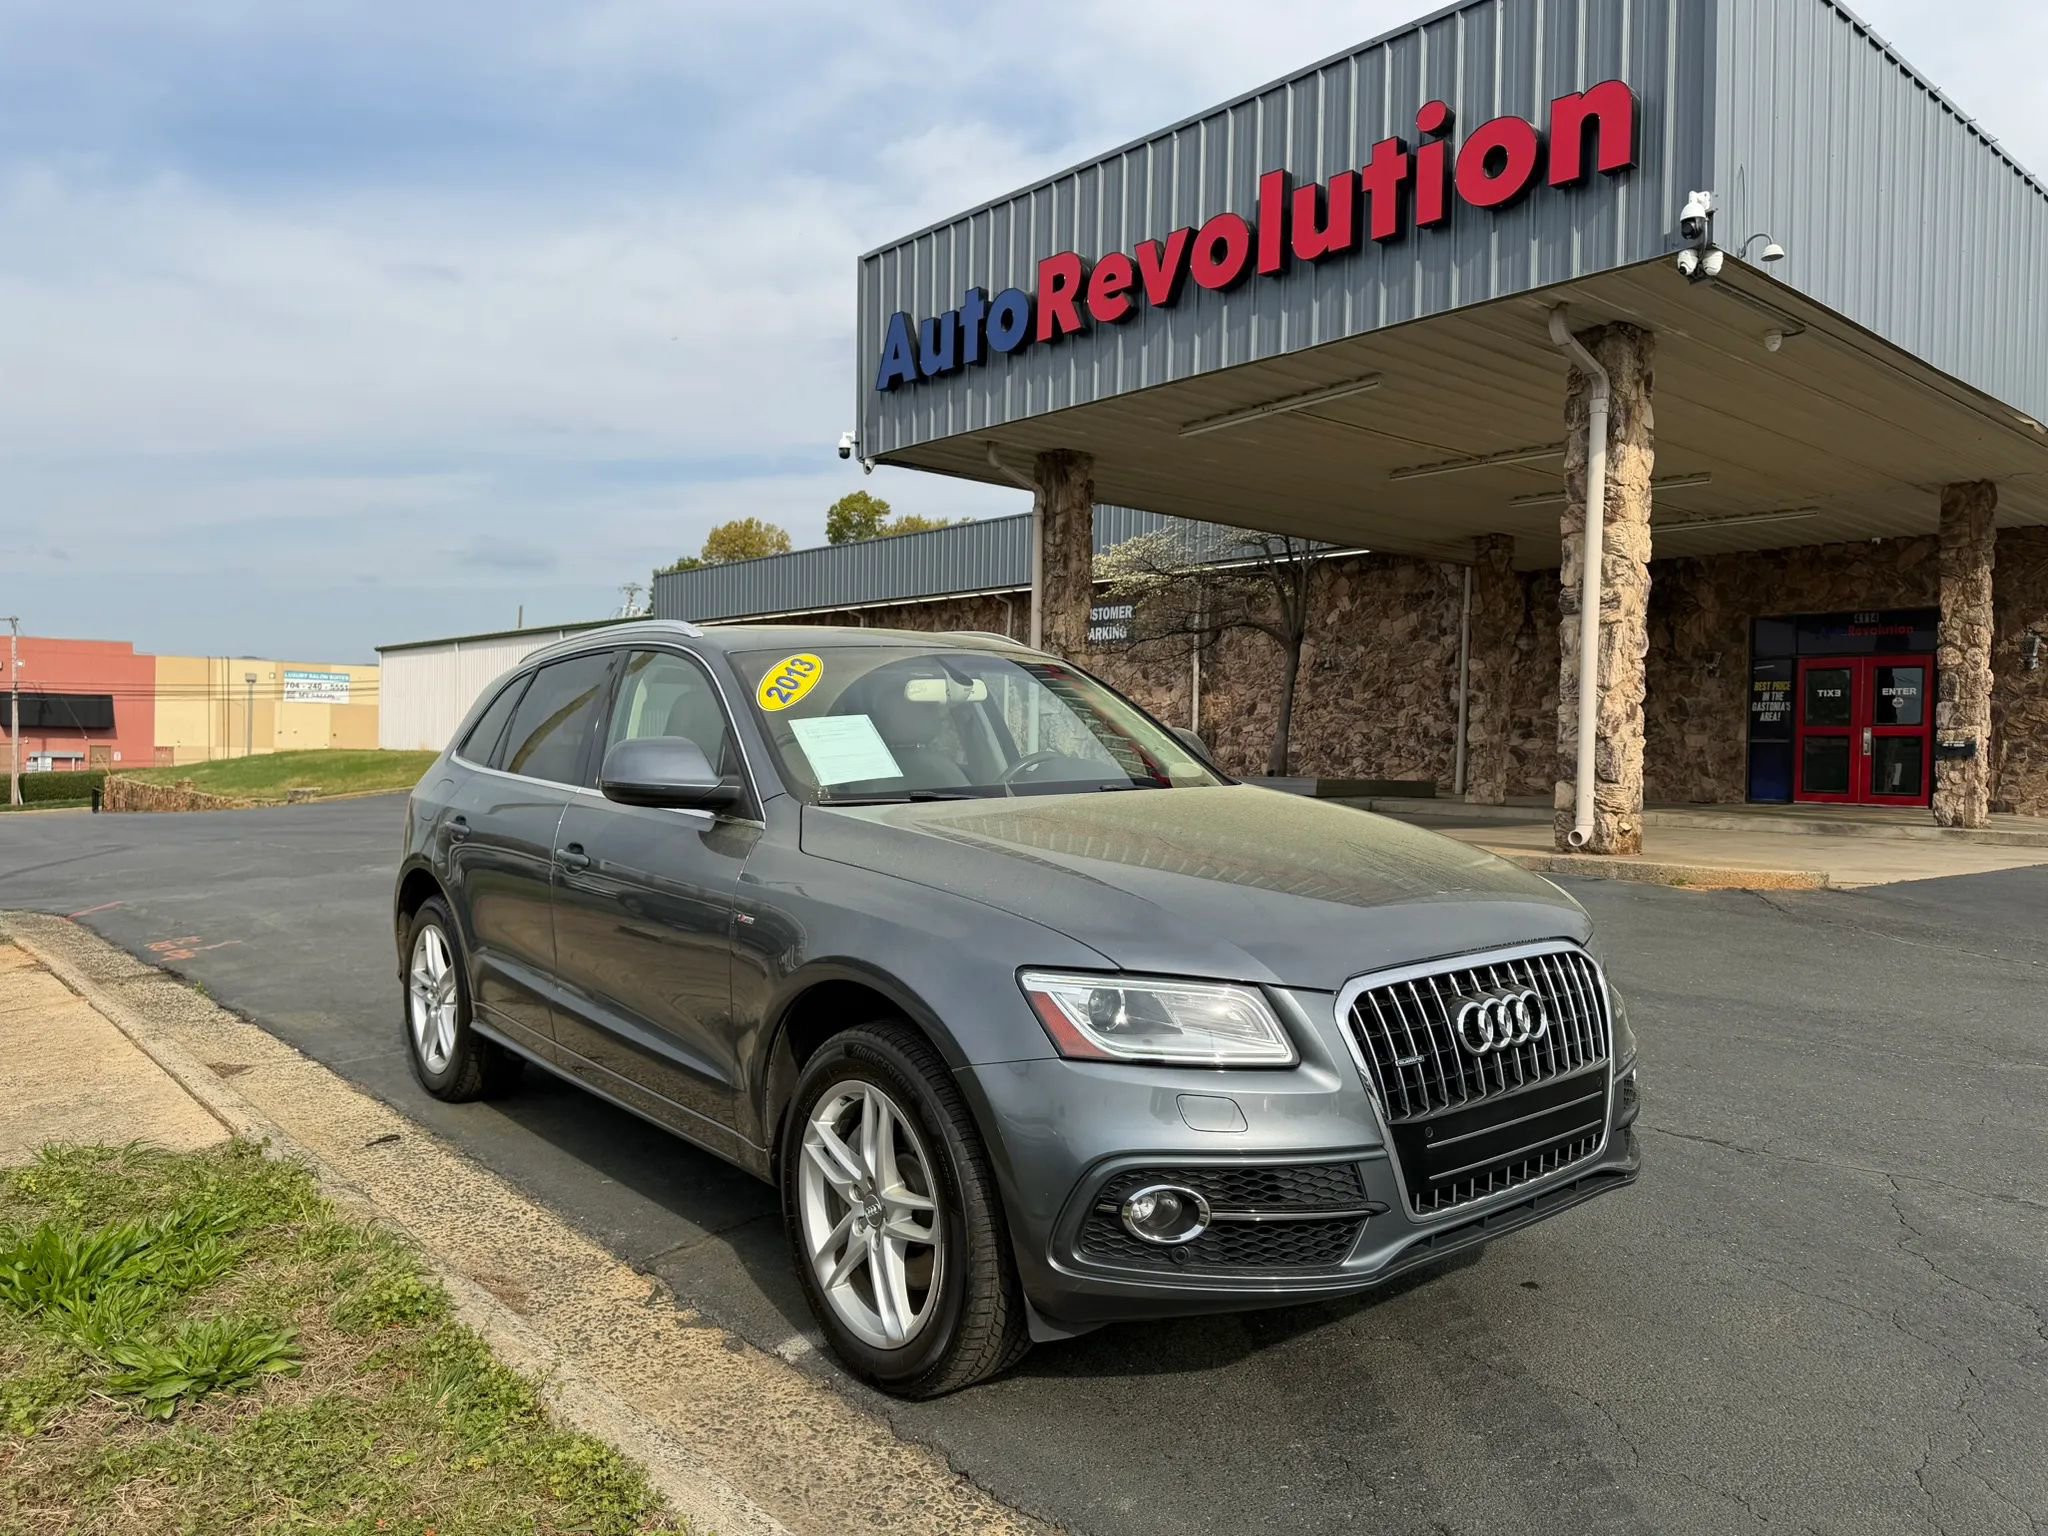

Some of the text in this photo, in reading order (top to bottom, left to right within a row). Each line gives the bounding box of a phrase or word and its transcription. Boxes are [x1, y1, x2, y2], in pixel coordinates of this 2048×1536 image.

[1090, 605, 1133, 620] STOMER
[1088, 626, 1127, 641] ARKING
[766, 658, 816, 704] 2013
[1754, 681, 1791, 691] BEST PRICE
[1762, 691, 1784, 701] IN THE
[1882, 687, 1917, 696] ENTER
[1752, 702, 1791, 712] GASTONIA'S
[1760, 712, 1781, 722] AREA!
